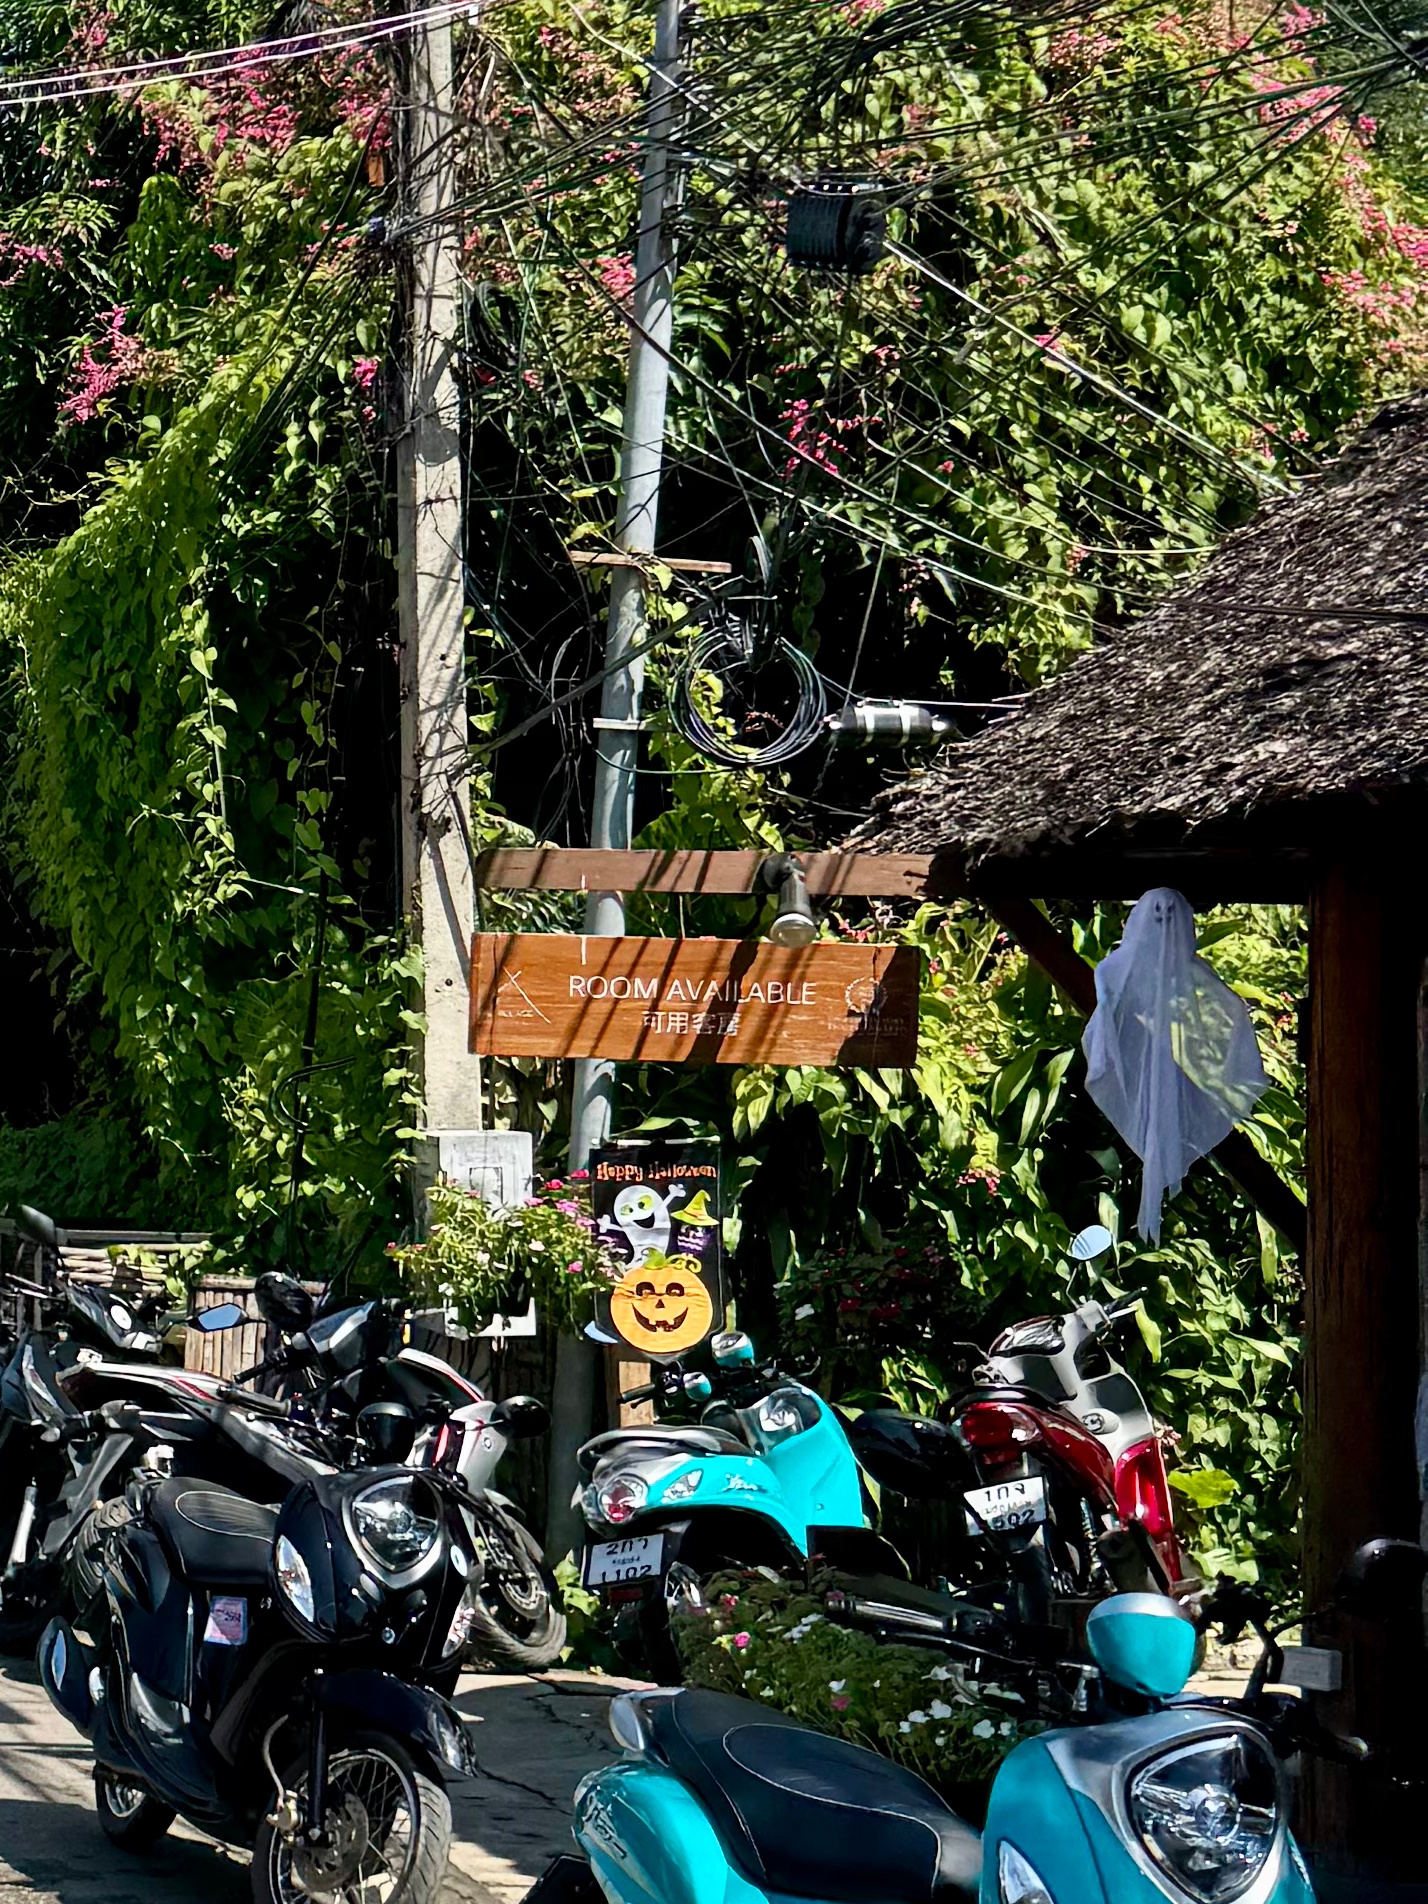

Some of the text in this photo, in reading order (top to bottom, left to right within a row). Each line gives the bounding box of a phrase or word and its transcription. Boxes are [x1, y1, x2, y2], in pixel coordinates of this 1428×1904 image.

[569, 975, 817, 1005] ROOM AVAILABLE
[596, 1161, 644, 1182] Happy
